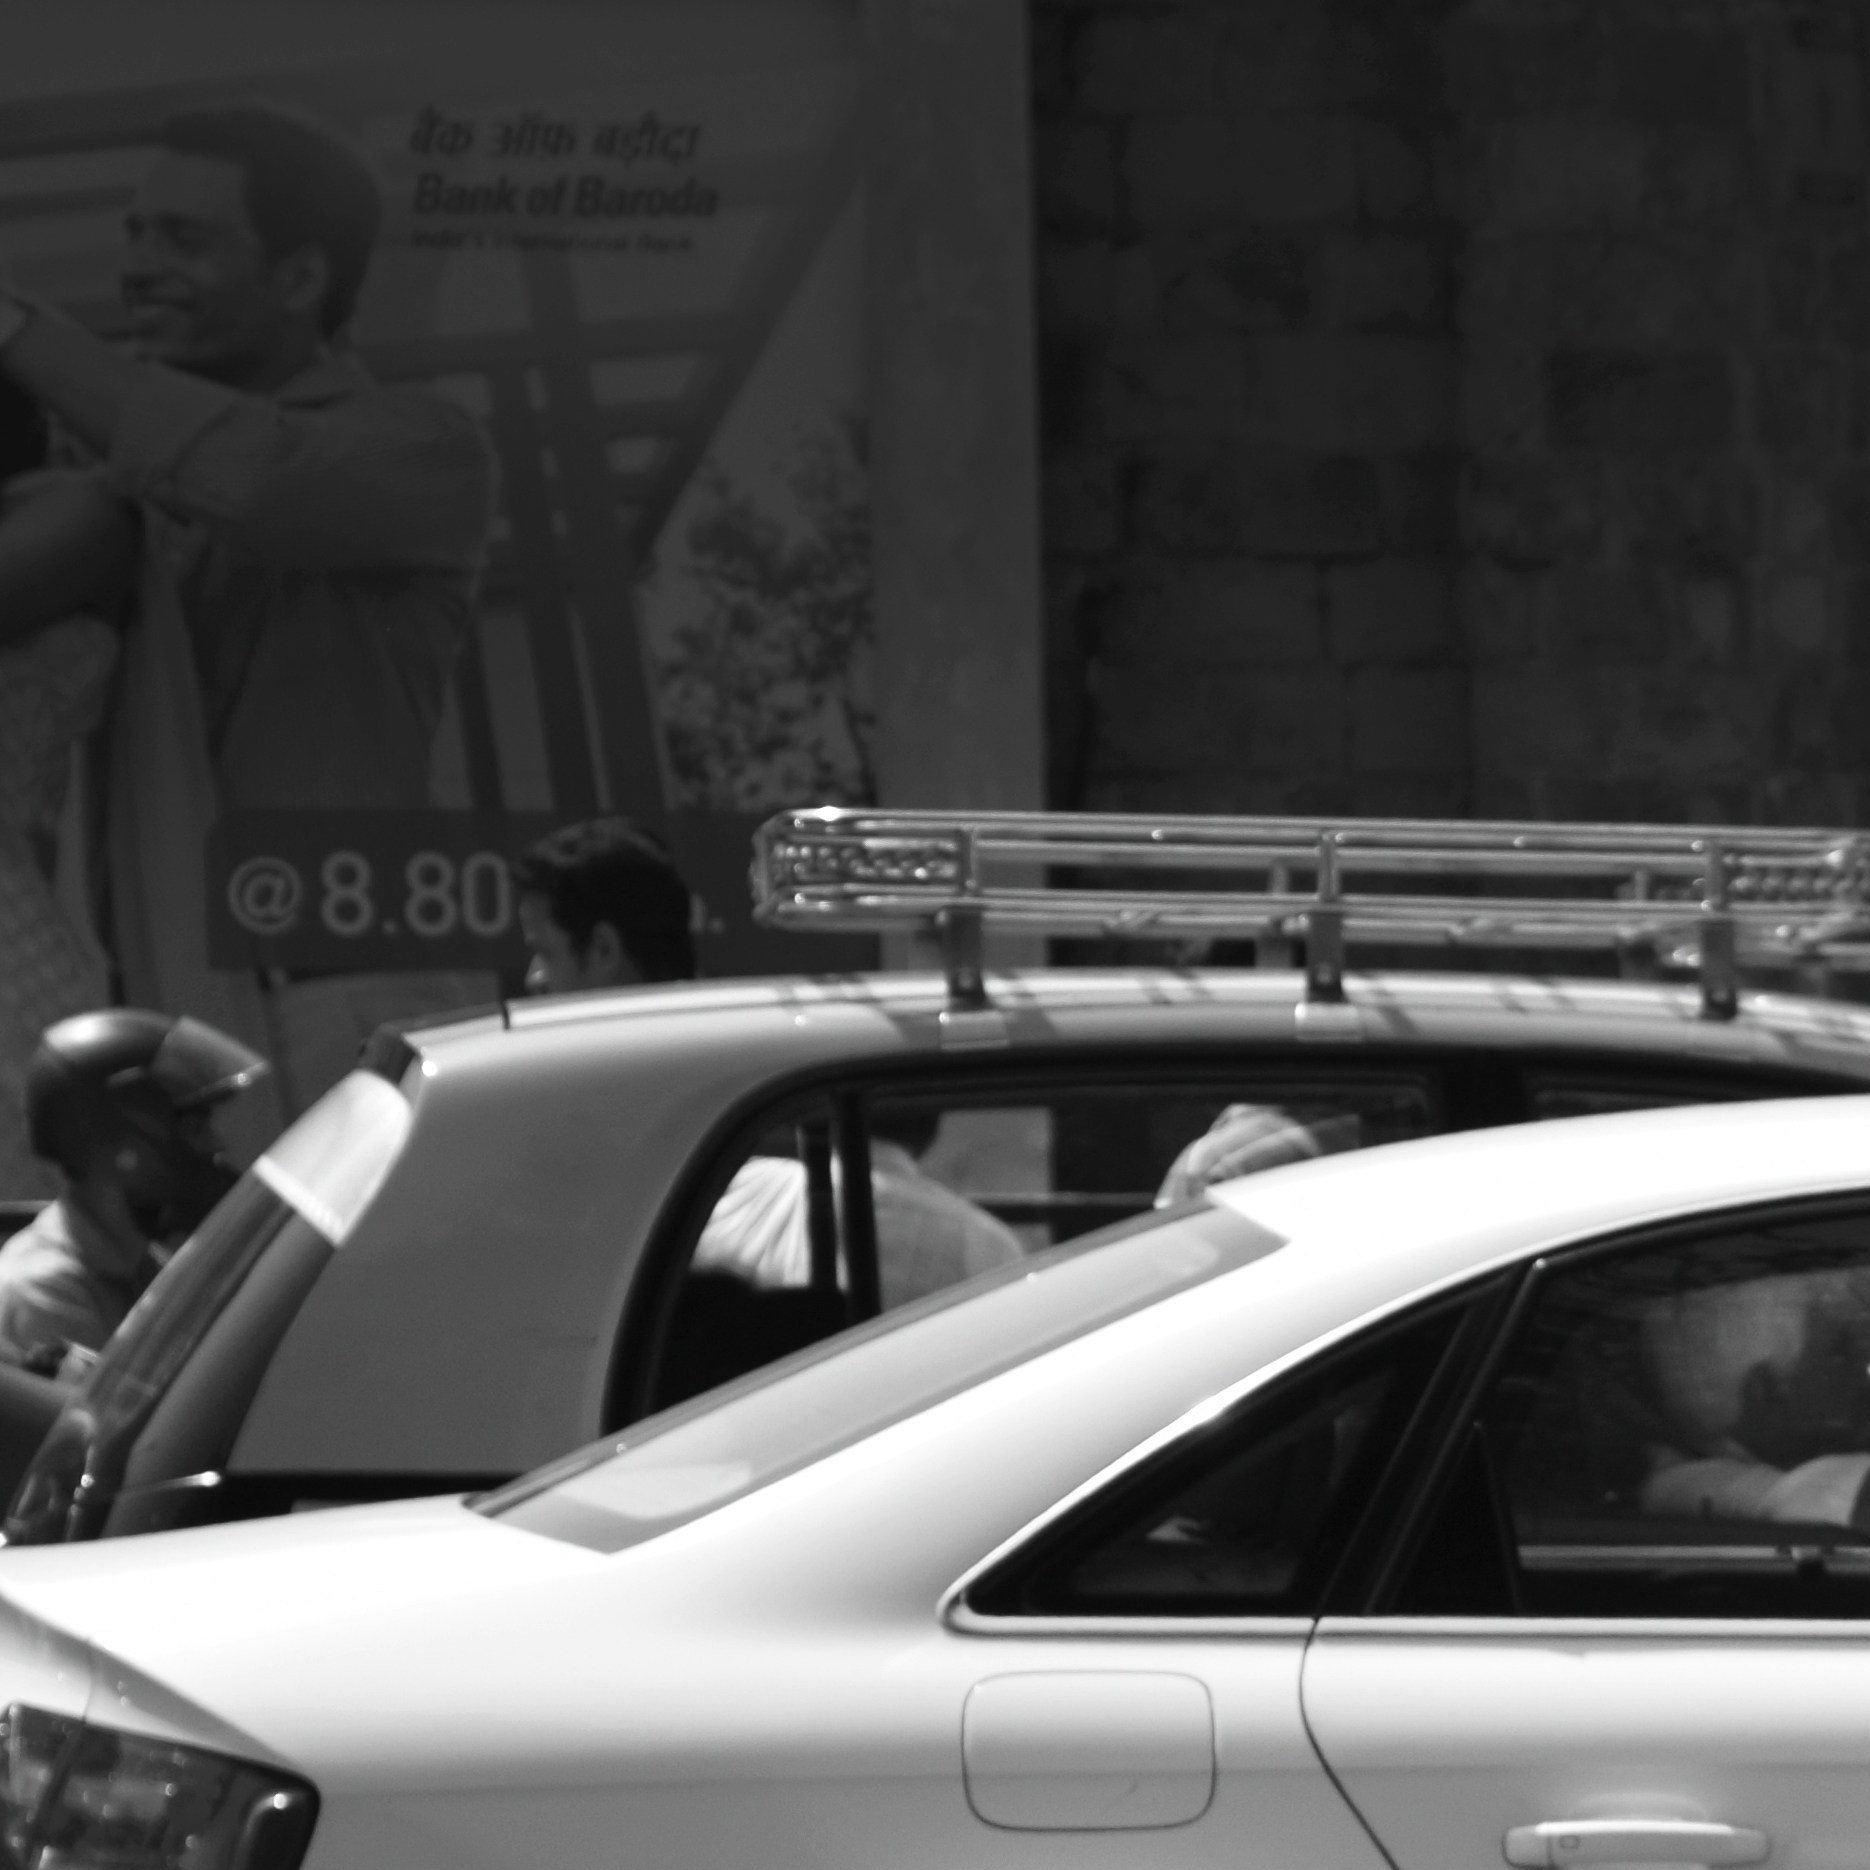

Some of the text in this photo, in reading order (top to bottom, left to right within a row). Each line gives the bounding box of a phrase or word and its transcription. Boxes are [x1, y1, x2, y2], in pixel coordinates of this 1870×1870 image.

[409, 104, 474, 154] बैंक
[412, 172, 719, 217] Bank of Baroda
